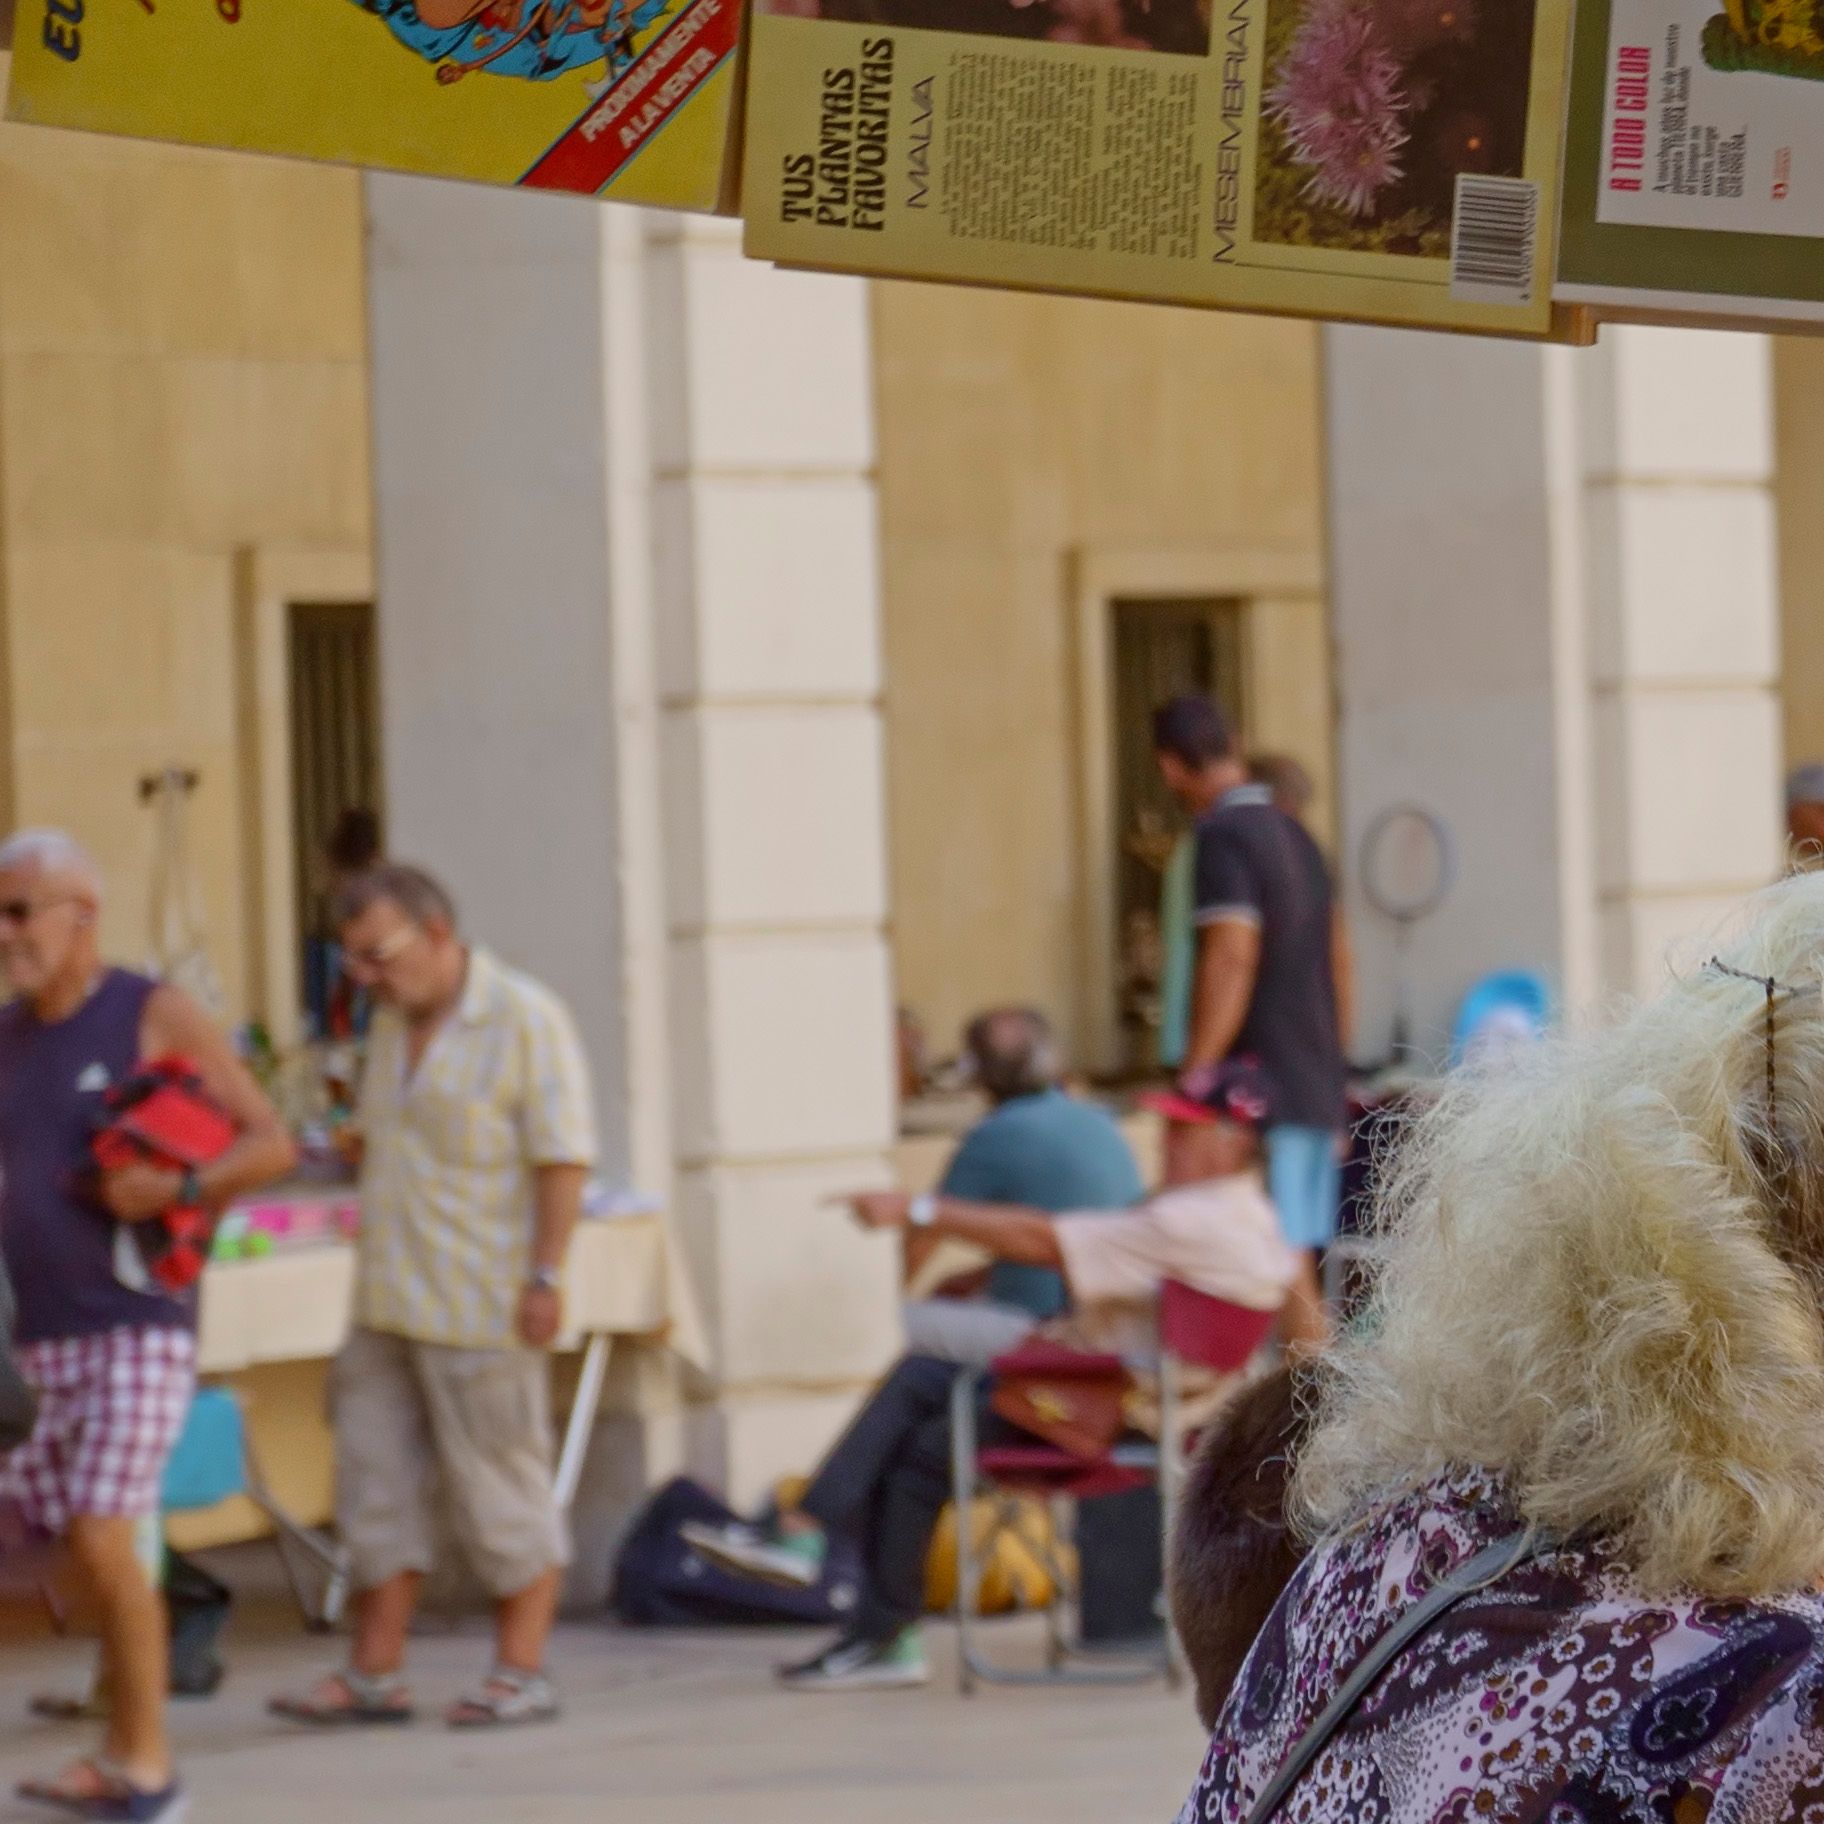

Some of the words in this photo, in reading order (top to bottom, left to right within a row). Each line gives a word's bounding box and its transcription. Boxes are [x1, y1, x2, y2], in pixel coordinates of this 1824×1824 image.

[780, 153, 815, 222] TUS
[816, 67, 856, 228] PLANTAS
[851, 37, 895, 233] FAVORITAS
[905, 76, 936, 210] MALVA
[1610, 117, 1647, 172] TODO
